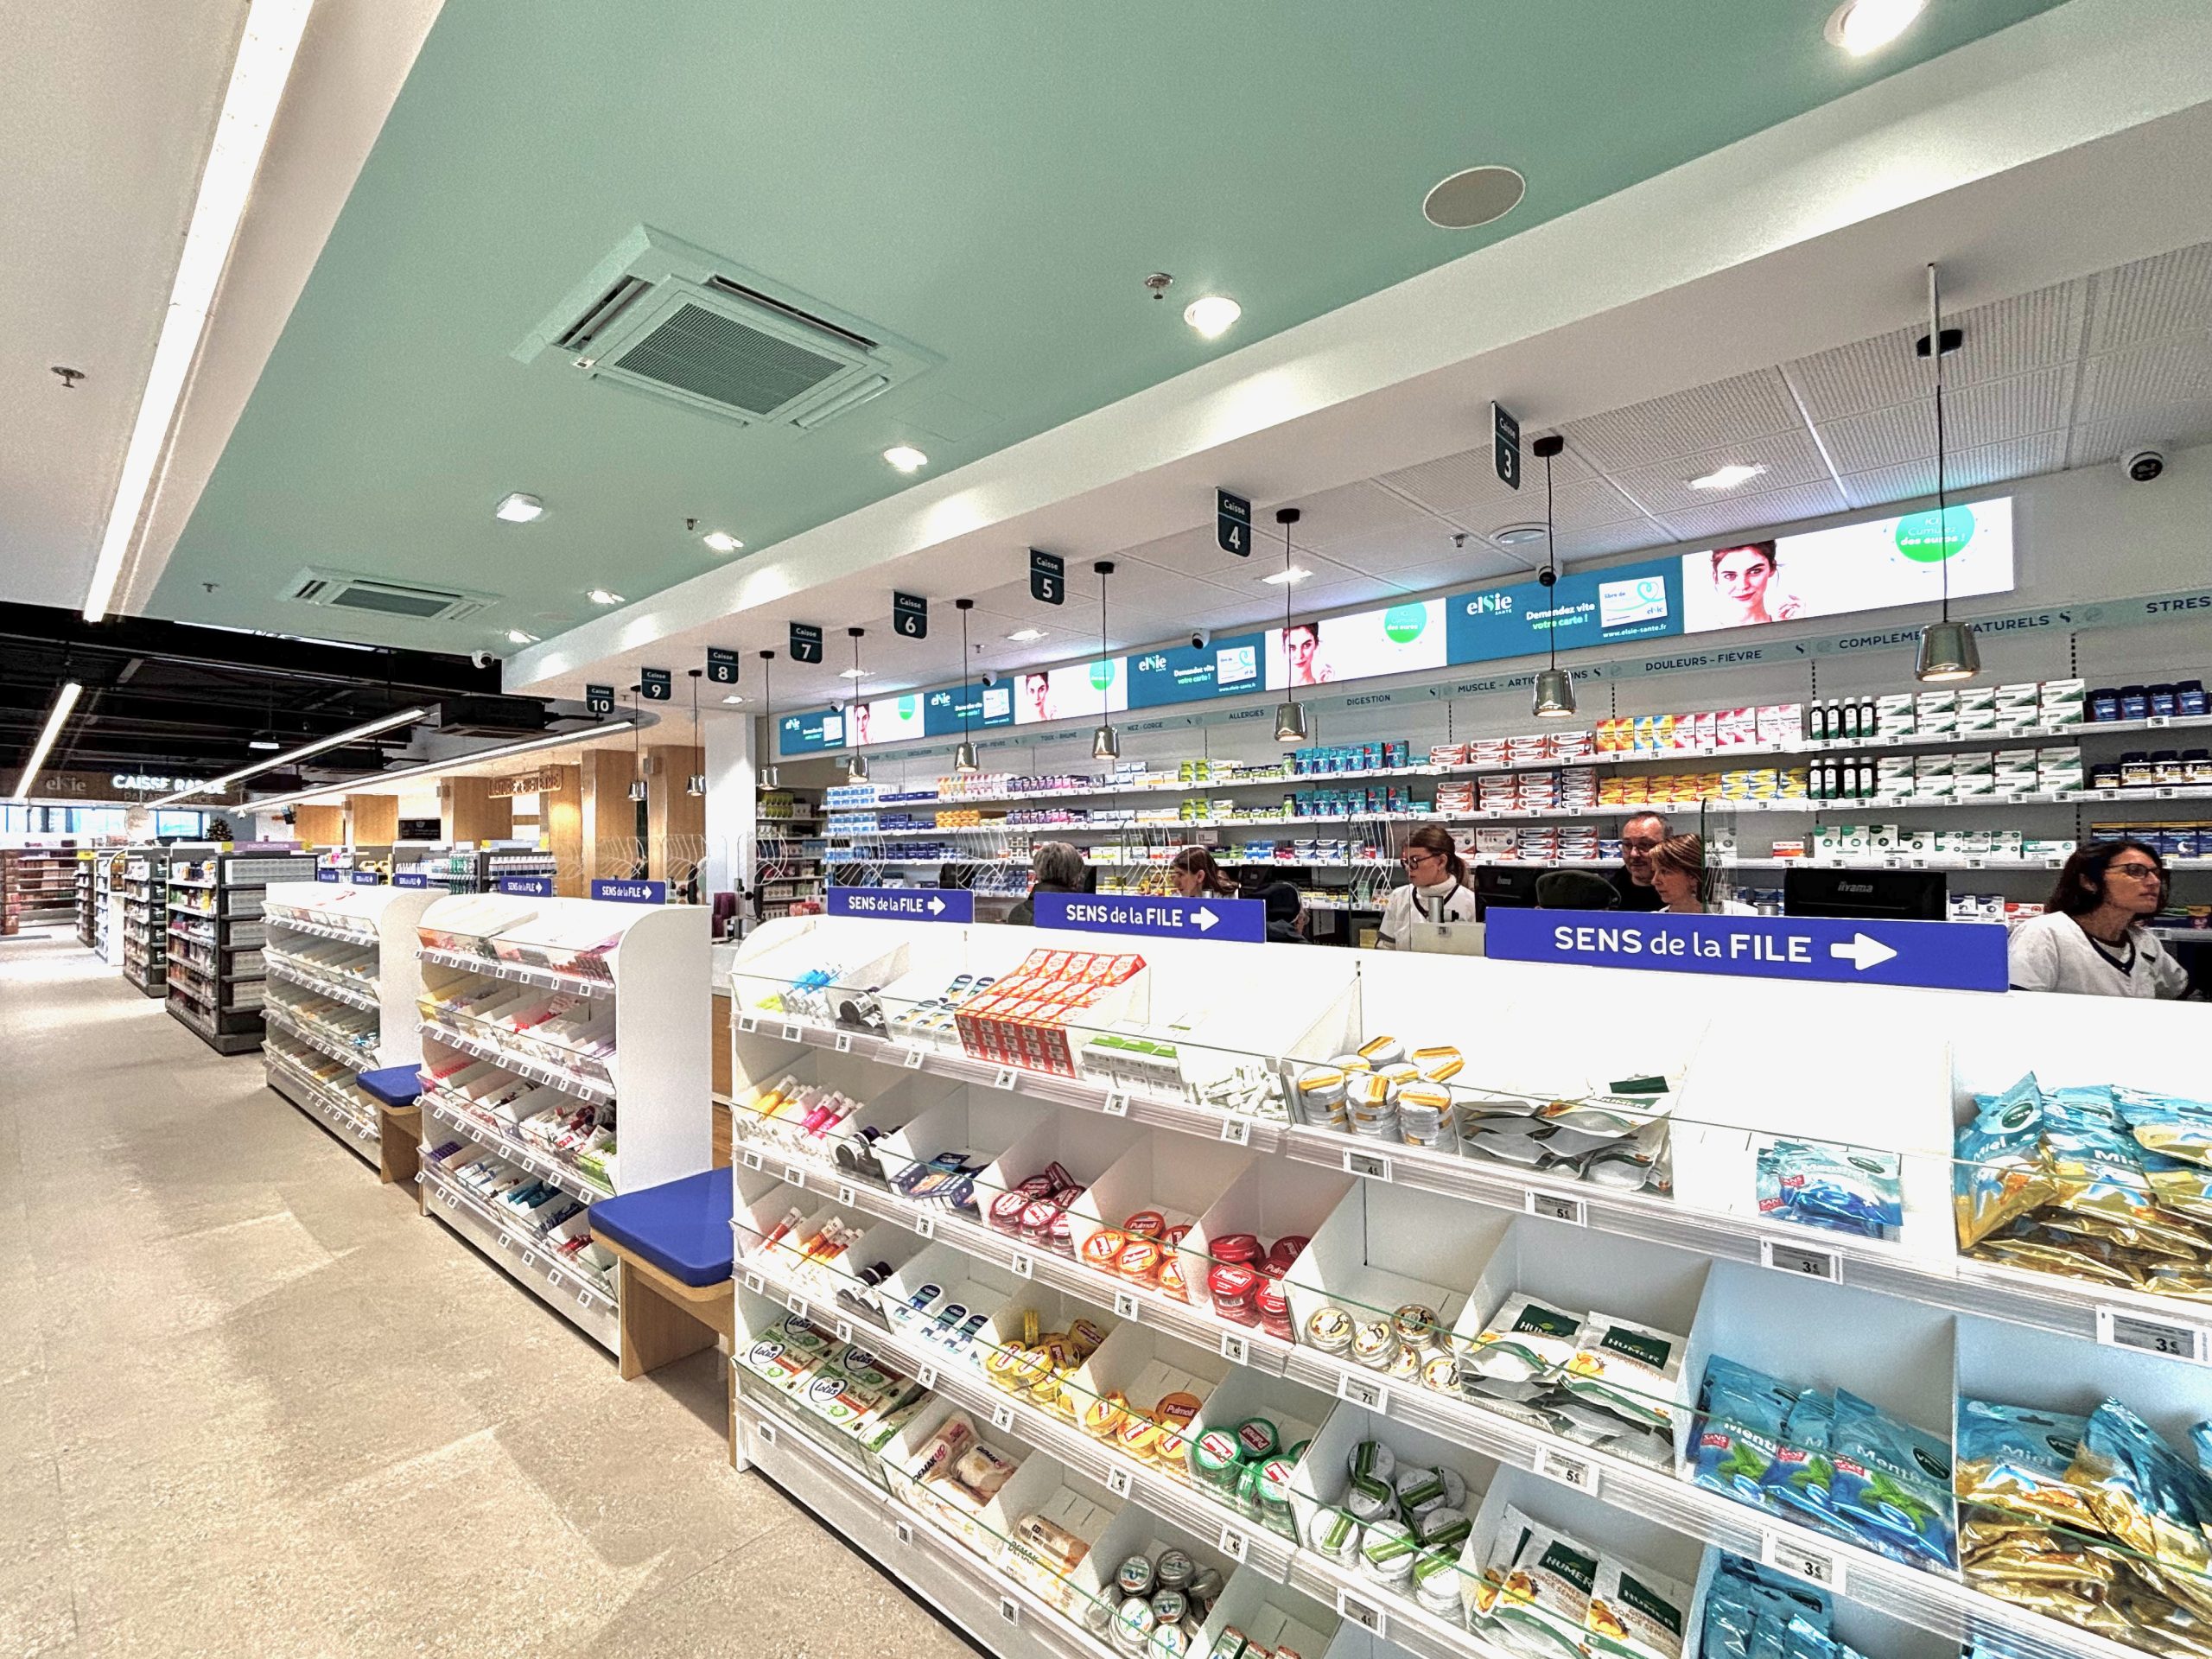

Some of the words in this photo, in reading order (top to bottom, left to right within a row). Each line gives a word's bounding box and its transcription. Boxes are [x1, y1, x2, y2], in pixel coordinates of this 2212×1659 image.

[1504, 448, 1512, 478] 3
[1224, 499, 1245, 516] Caisse
[1229, 525, 1241, 550] 4
[1908, 526, 1956, 537] Cumuez
[1900, 537, 1922, 545] des
[1037, 556, 1058, 570] Caisse
[1043, 578, 1053, 599] 5
[899, 597, 922, 609] Caisse
[1526, 605, 1575, 620] Demandez
[1576, 602, 1595, 612] vite
[905, 616, 916, 634] 6
[1532, 620, 1557, 630] votre
[1559, 615, 1584, 626] carte
[1974, 614, 2050, 632] ATURELS
[796, 627, 817, 638] Caisse
[1603, 623, 1667, 639] www.elsie-sante.fr
[713, 652, 734, 660] Caisse
[801, 644, 812, 659] 7
[1645, 656, 1707, 671] DOULEURS
[718, 666, 728, 681] 8
[652, 684, 661, 697] 9
[1458, 681, 1496, 693] MUSCLE
[591, 700, 609, 712] 10
[1346, 694, 1390, 706] DIGESTION
[1229, 709, 1264, 720] ALLERGIES
[112, 774, 170, 790] CAISSE
[601, 886, 616, 896] SENS
[628, 887, 641, 897] FILE
[849, 895, 875, 911] SENS
[877, 896, 888, 911] de
[890, 897, 899, 912] la
[900, 898, 924, 913] FILE
[1066, 904, 1108, 924] SENS
[1110, 906, 1127, 925] de
[1129, 906, 1144, 925] la
[1147, 907, 1183, 927] FILE
[1554, 925, 1643, 954] SENS
[1649, 929, 1686, 957] de
[1693, 932, 1721, 958] la
[1731, 934, 1812, 963] FILE
[1129, 1221, 1158, 1230] Pulmoll
[789, 1317, 811, 1330] Lotus
[754, 1346, 776, 1359] Lotus
[849, 1351, 872, 1364] Lotus
[1608, 1338, 1660, 1363] HUMER
[814, 1382, 838, 1395] Lotus
[1166, 1404, 1196, 1417] Pulmoll
[1546, 1556, 1594, 1589] HUMER
